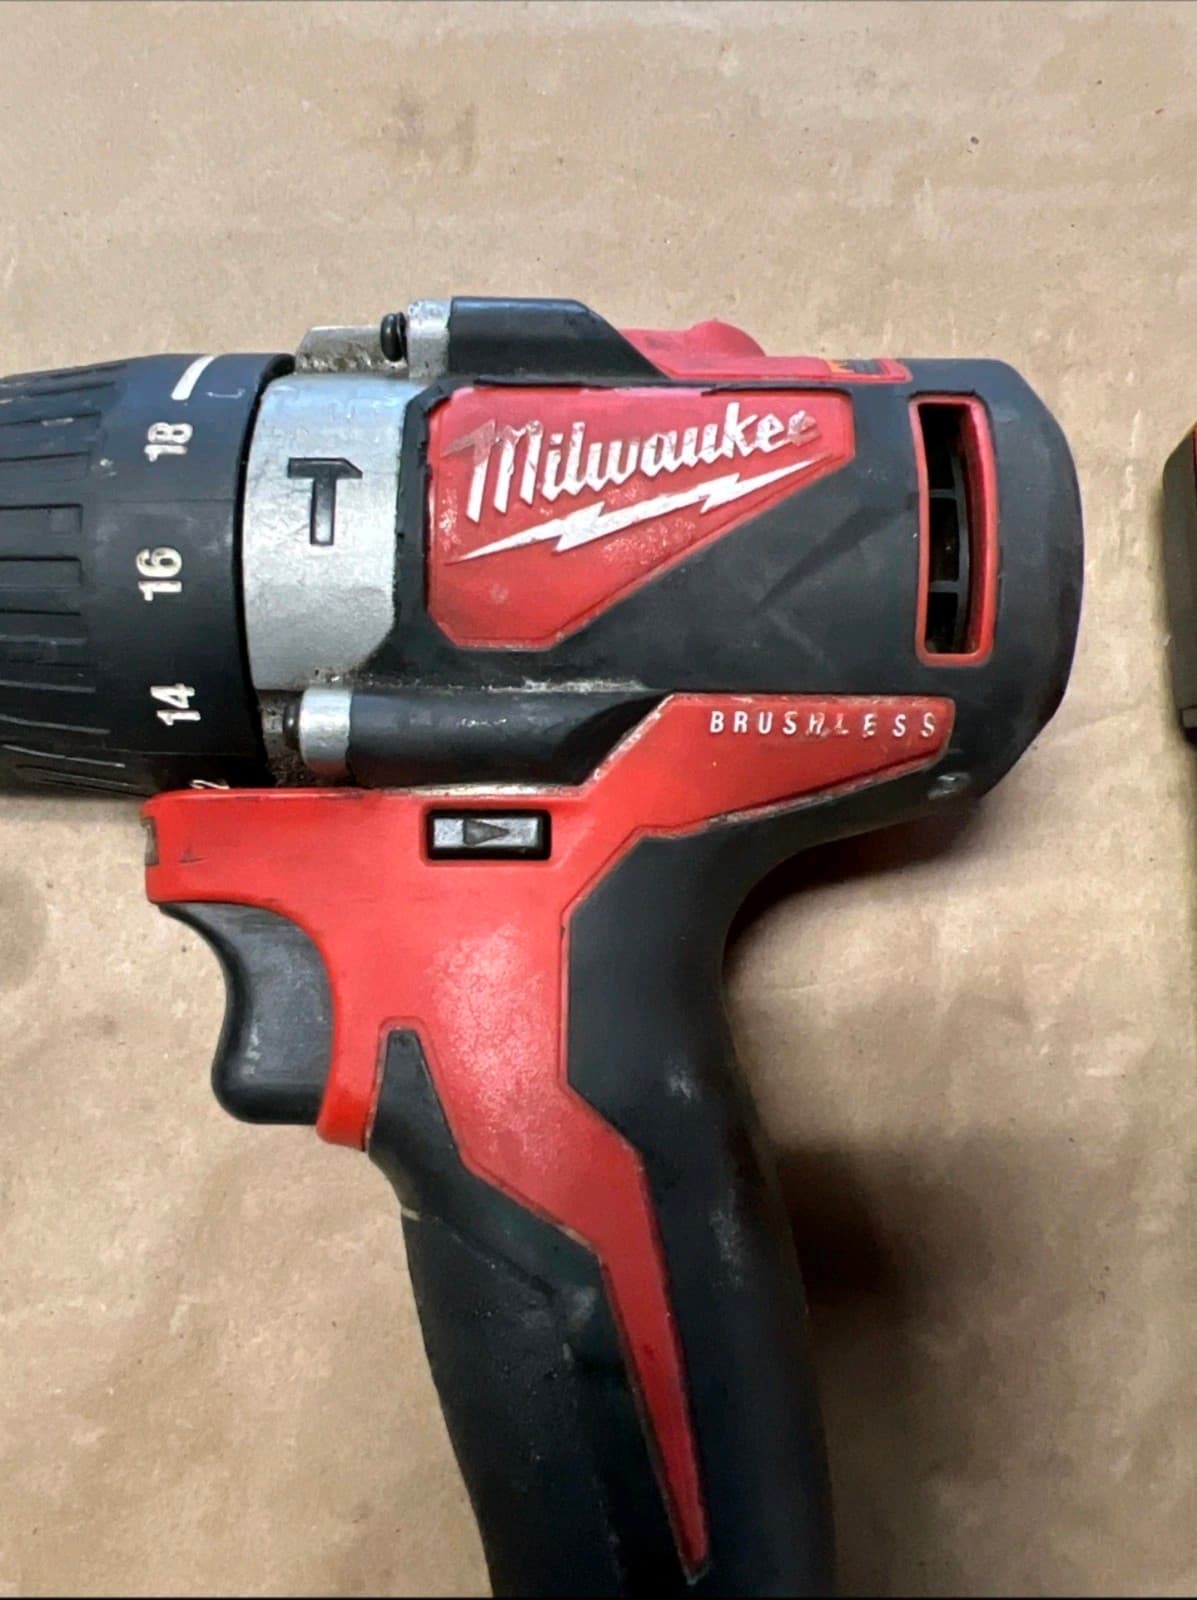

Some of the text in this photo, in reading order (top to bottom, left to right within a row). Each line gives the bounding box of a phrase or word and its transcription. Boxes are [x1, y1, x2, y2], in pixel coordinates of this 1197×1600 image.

[144, 421, 194, 462] 18
[440, 401, 821, 523] Milwaukee
[136, 547, 183, 602] 16
[150, 683, 201, 726] 14
[709, 710, 938, 738] BRUSHLESS
